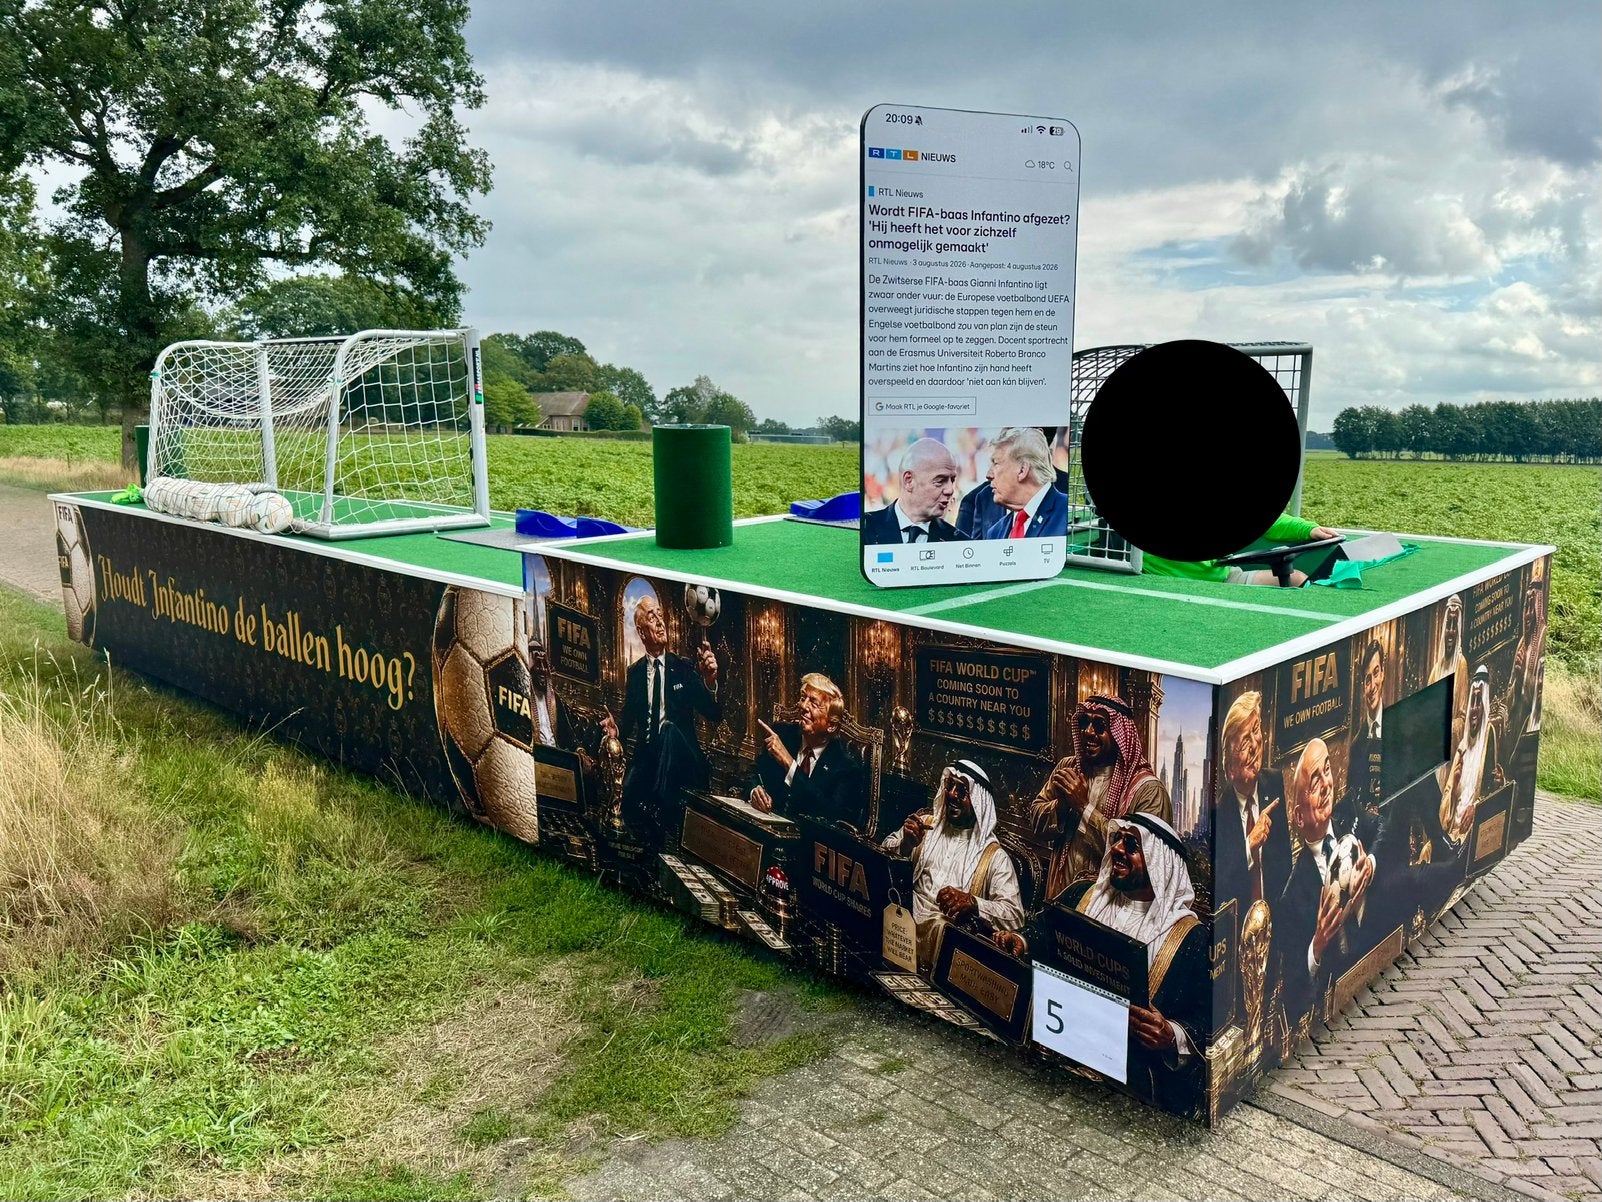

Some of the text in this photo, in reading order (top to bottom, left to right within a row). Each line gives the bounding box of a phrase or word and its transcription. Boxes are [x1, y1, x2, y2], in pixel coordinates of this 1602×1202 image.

[886, 113, 912, 124] 20:09
[921, 152, 956, 163] NIEUWS
[1038, 161, 1055, 169] 18°C
[878, 188, 923, 198] RTL Nieuws
[869, 204, 1070, 226] Wordt FIFA-baas Infantino afgezet?
[868, 221, 1017, 238] 'Hij heeft het voor zichzelf
[868, 238, 989, 253] onmogelijk gemaakt'
[918, 260, 948, 269] augustus
[950, 260, 966, 268] 2026
[1012, 263, 1042, 272] augustus
[1042, 263, 1058, 271] 2026
[869, 275, 1048, 290] De Zwitserse FIFA-baas Gianni Infantino ligt
[896, 291, 920, 300] onder
[945, 292, 956, 301] de
[957, 293, 995, 303] Europese
[997, 293, 1046, 303] voetbalbond
[1048, 295, 1069, 303] UEFA
[868, 305, 913, 315] overweegt
[914, 306, 954, 316] juridische
[956, 307, 989, 318] stappen
[991, 308, 1013, 318] tegen
[1015, 308, 1032, 316] hem
[1045, 308, 1056, 317] de
[868, 320, 902, 330] Engelse
[904, 320, 956, 330] voetbalbond
[990, 321, 1007, 333] plan
[1009, 322, 1023, 333] zijn
[1024, 322, 1034, 331] de
[1036, 323, 1057, 331] steun
[889, 334, 907, 343] hem
[909, 334, 942, 344] formeel
[943, 336, 953, 346] op
[955, 335, 964, 344] te
[965, 337, 996, 346] zeggen.
[998, 336, 1026, 344] Docent
[1028, 336, 1068, 346] sportrecht
[887, 349, 898, 357] de
[899, 349, 936, 358] Erasmus
[938, 349, 983, 358] Universiteit
[985, 350, 1017, 358] Roberto
[1018, 350, 1046, 358] Branco
[868, 363, 901, 372] Martins
[937, 364, 973, 372] Infantino
[974, 364, 988, 374] zijn
[990, 364, 1010, 372] hand
[1011, 364, 1032, 372] heeft
[868, 377, 914, 388] overspeeld
[928, 377, 965, 386] daardoor
[966, 377, 984, 386] 'niet
[924, 403, 970, 411] Google-favoriet
[58, 506, 73, 524] FIFA
[98, 554, 415, 710] Houdt Infantino de ballen hoog?
[558, 616, 590, 649] FIFA
[930, 659, 953, 673] FIFA
[956, 662, 999, 680] WORLD
[1290, 652, 1339, 704] FIFA
[936, 678, 1019, 700] COMING SOON TO
[498, 685, 531, 719] FIFA
[928, 692, 1031, 717] A COUNTRY NEAR YOU
[1284, 714, 1294, 728] WE
[1295, 708, 1310, 724] OWN
[814, 841, 869, 901] FIFA
[766, 874, 789, 890] APPROVE
[1055, 929, 1130, 980] WORLD CUPS
[1045, 998, 1064, 1034] 5
